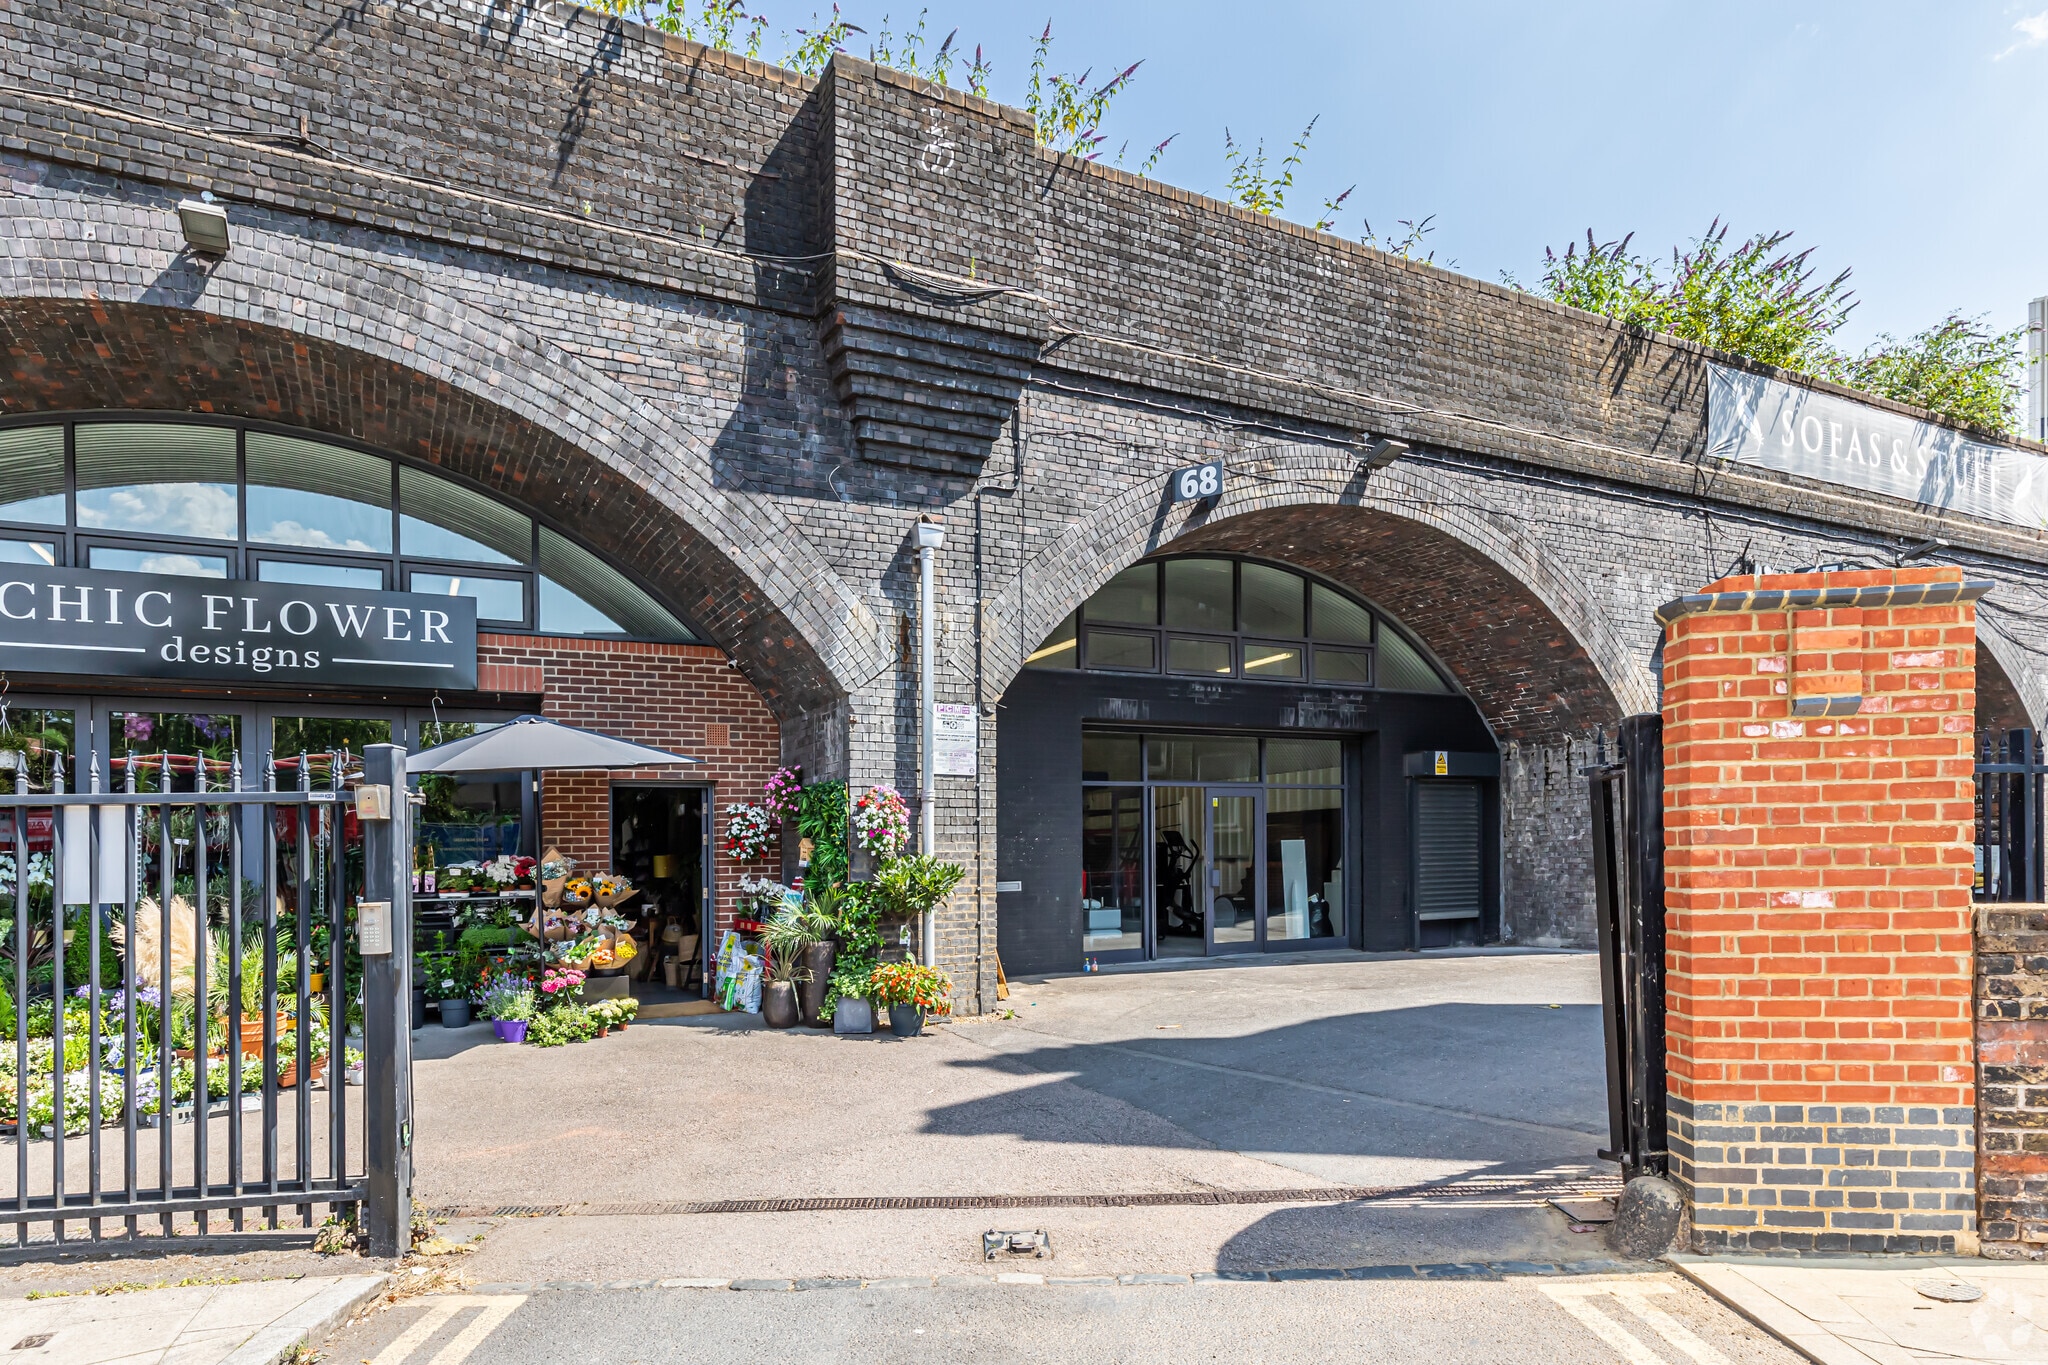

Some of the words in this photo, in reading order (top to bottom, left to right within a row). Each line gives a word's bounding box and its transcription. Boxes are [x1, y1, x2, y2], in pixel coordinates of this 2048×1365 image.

[1181, 466, 1218, 498] 68
[0, 582, 173, 627] CHIC
[202, 594, 453, 643] FLOWER
[161, 636, 321, 672] designs
